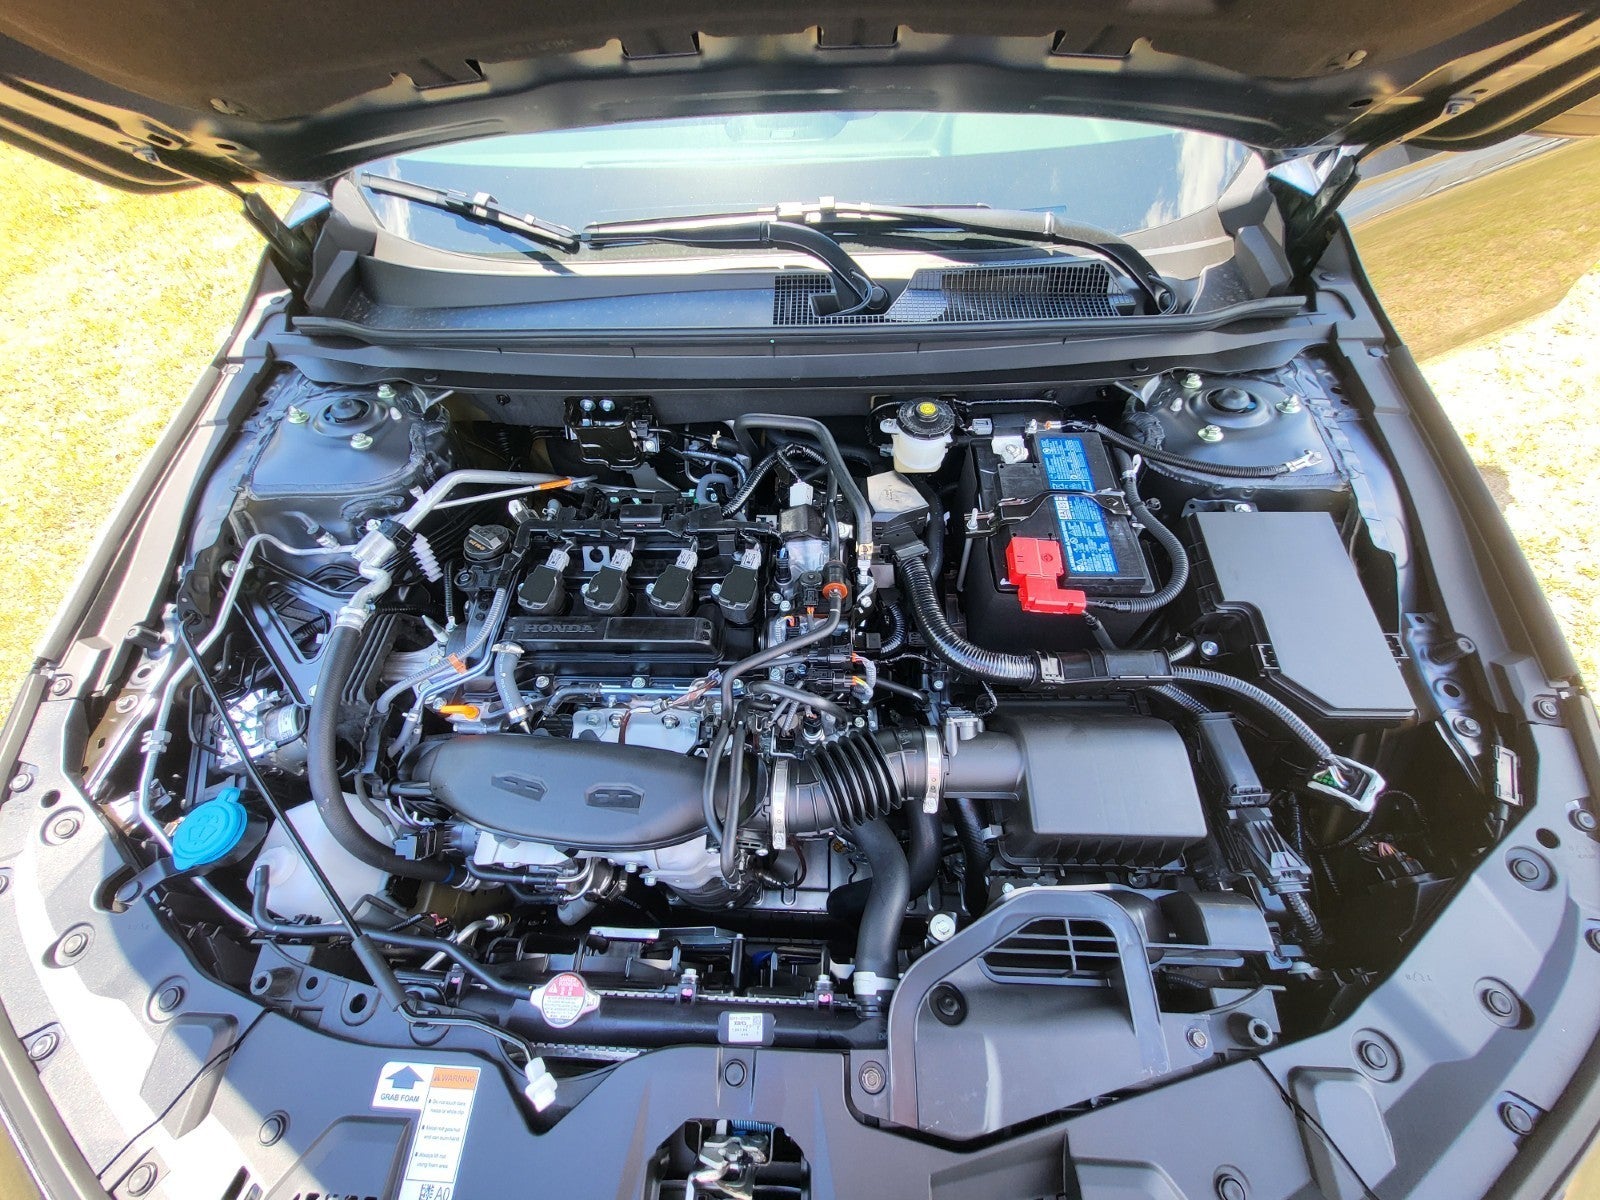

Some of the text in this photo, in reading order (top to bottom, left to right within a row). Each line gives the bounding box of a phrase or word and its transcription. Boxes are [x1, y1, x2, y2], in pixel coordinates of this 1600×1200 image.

[523, 623, 596, 633] HONDA
[441, 1073, 475, 1083] WARNING
[380, 1093, 420, 1103] GRAB FOAM
